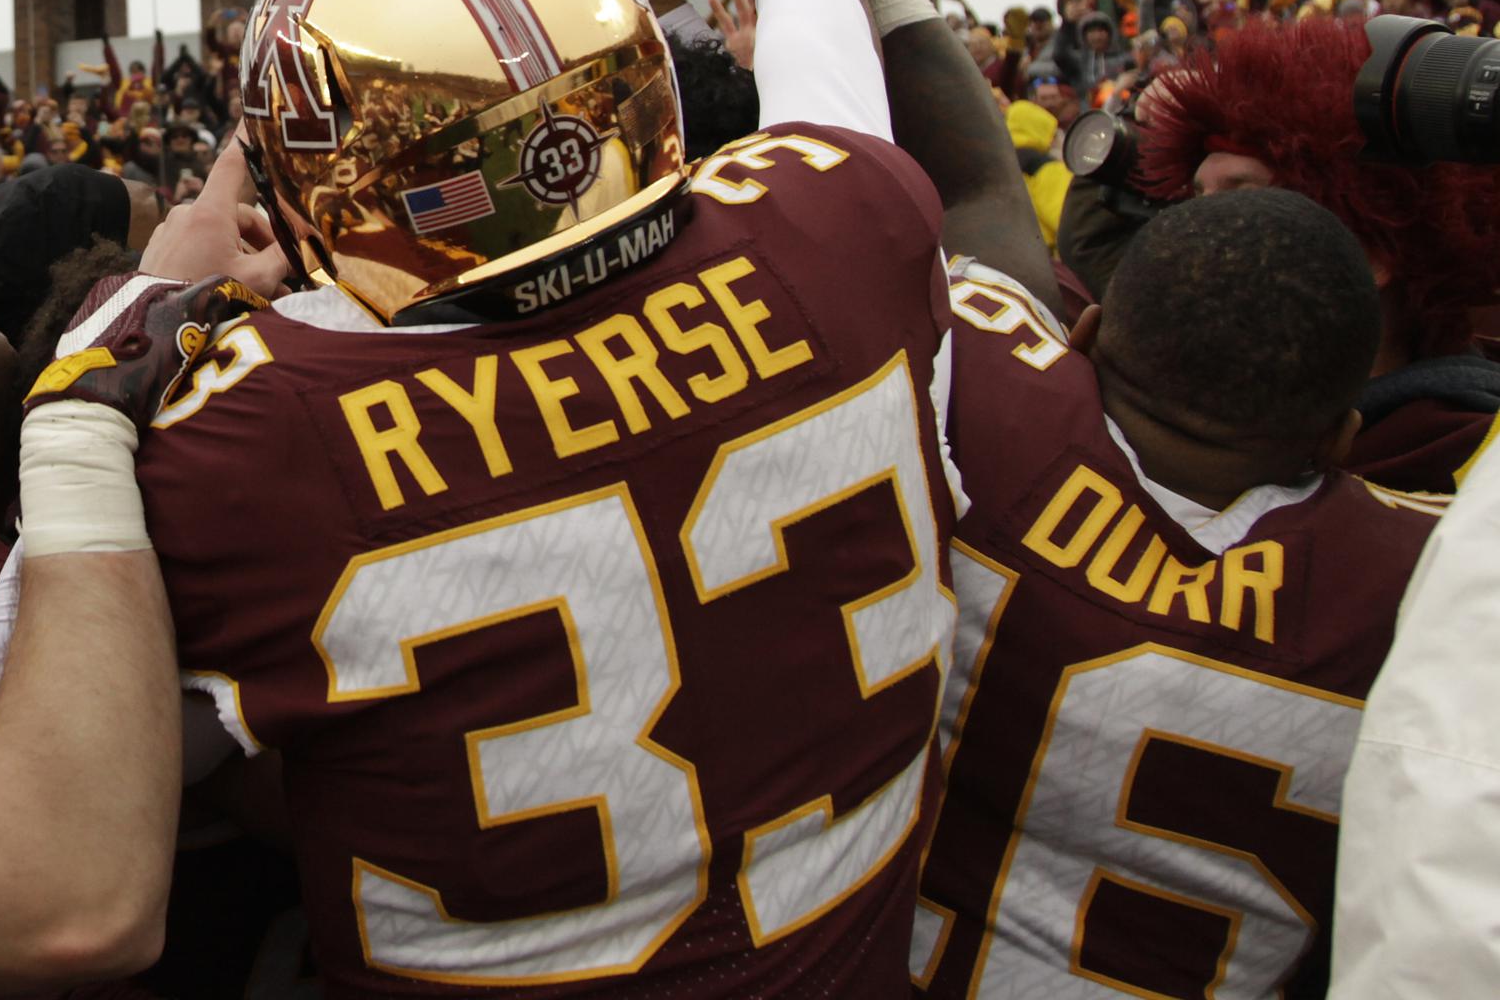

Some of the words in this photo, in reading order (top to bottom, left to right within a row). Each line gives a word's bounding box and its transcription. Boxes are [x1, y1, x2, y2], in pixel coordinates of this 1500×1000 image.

[539, 138, 585, 184] 33
[514, 208, 675, 314] SKI-U-MAH
[338, 256, 814, 512] RYERSE
[1022, 464, 1284, 645] DURR
[311, 348, 958, 987] 33
